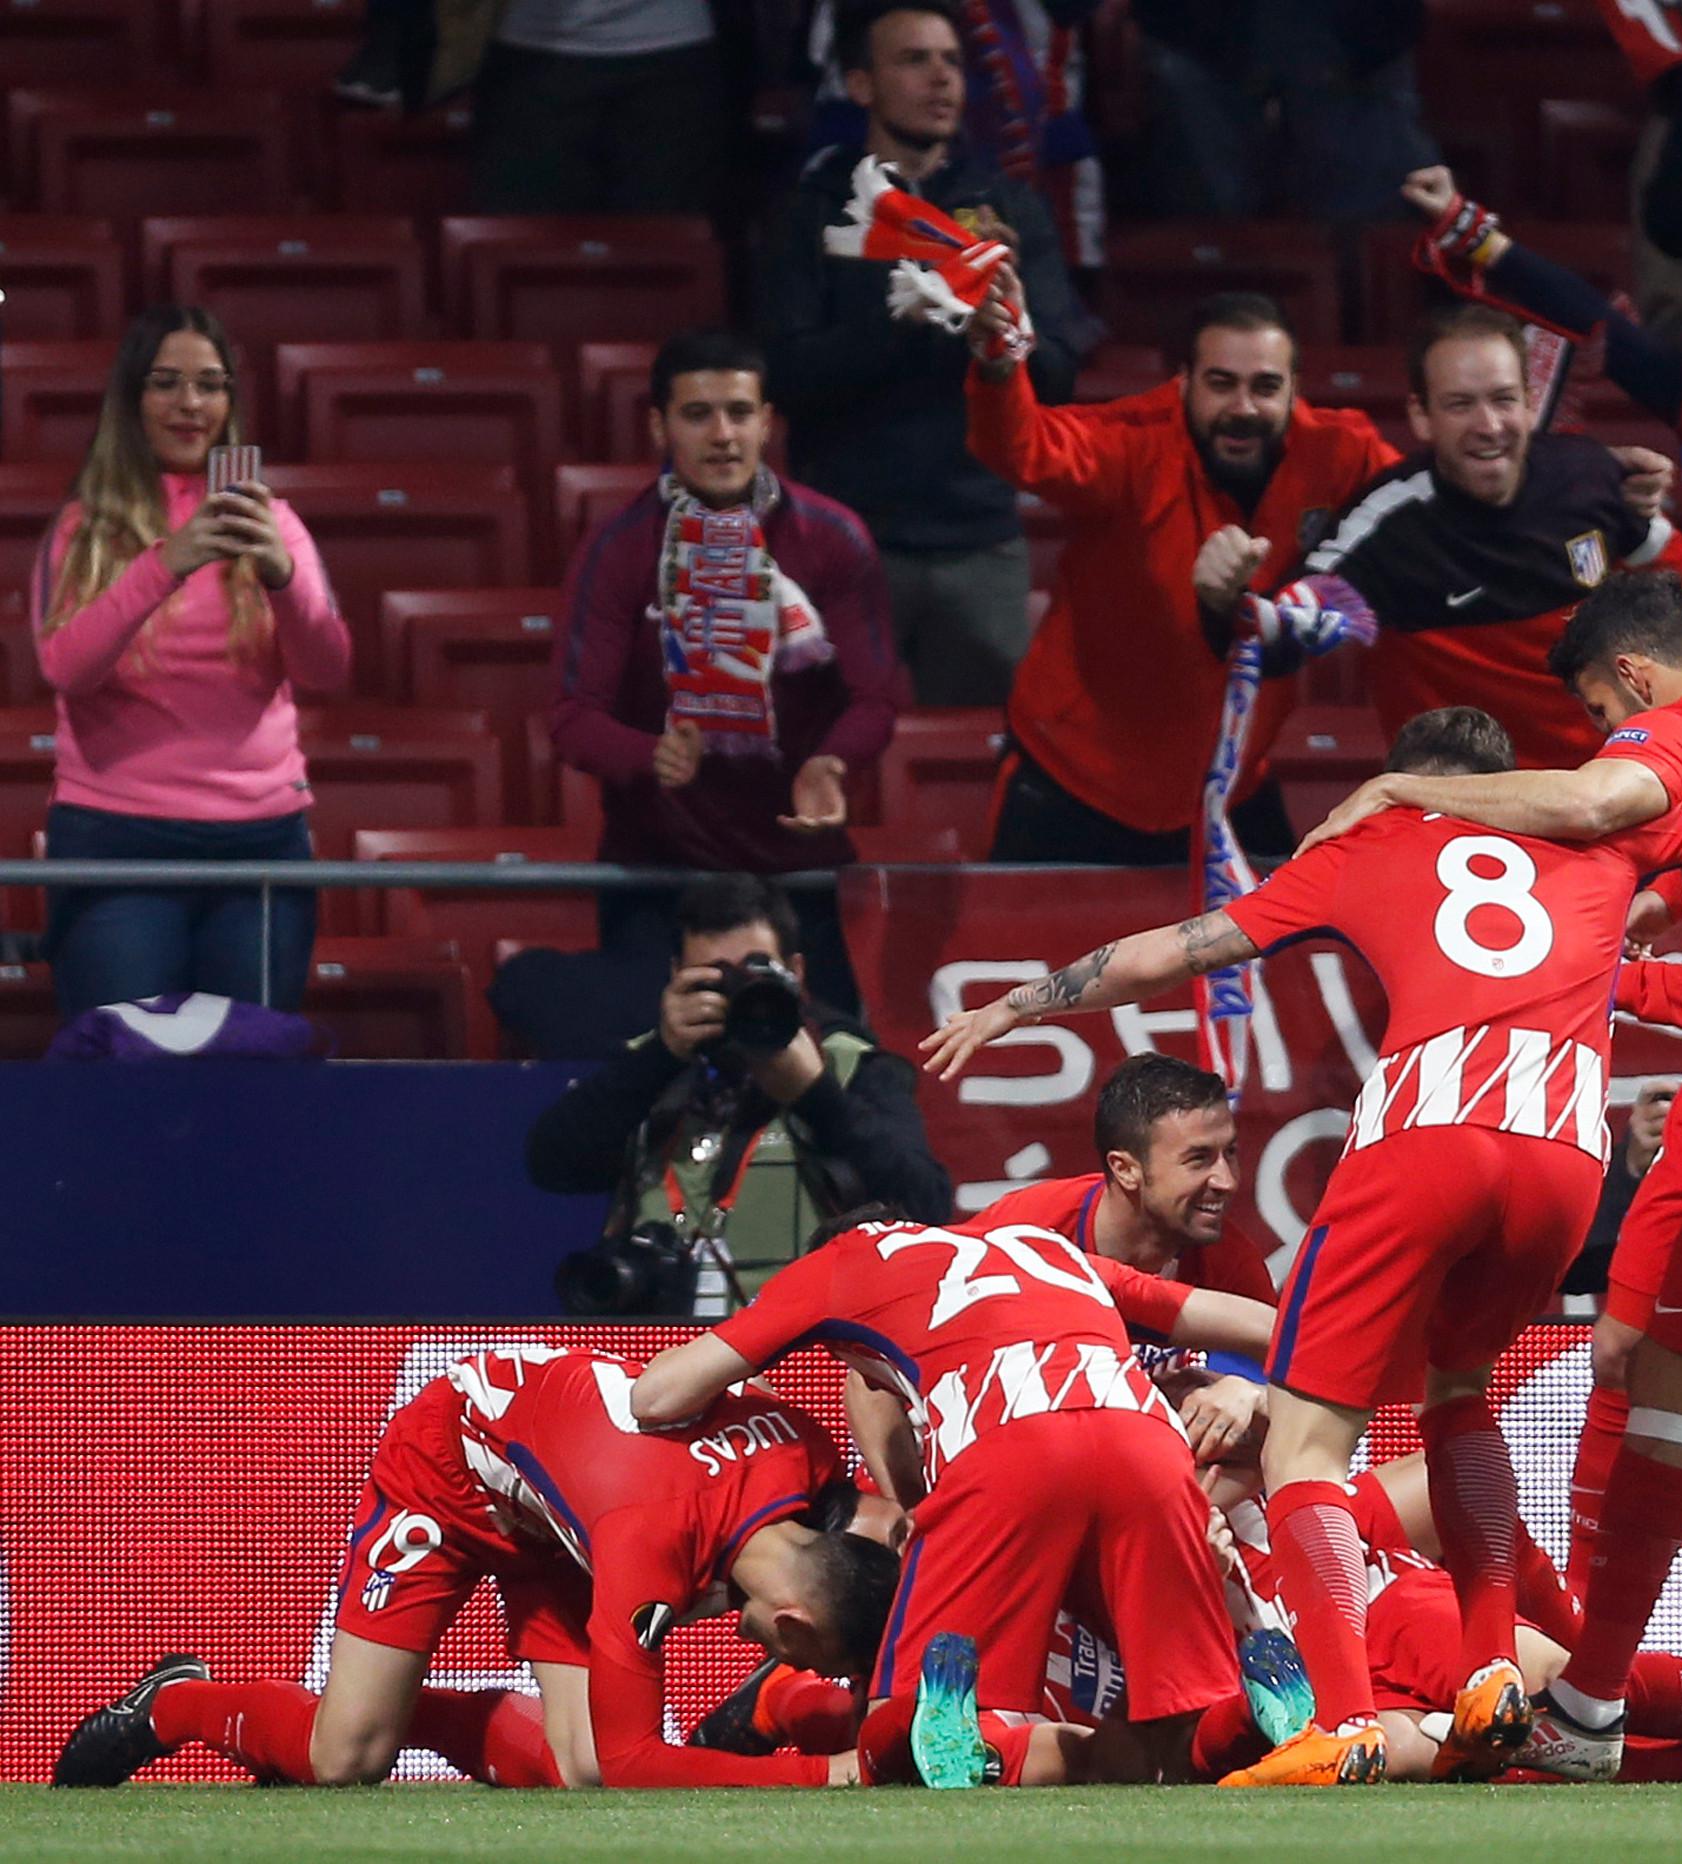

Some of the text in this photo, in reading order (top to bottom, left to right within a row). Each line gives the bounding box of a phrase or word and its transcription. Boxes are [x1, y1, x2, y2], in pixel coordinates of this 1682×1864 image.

[1434, 835, 1554, 978] 8
[876, 1224, 1114, 1330] 20
[689, 1410, 800, 1477] LUCAS
[368, 1509, 443, 1574] 19
